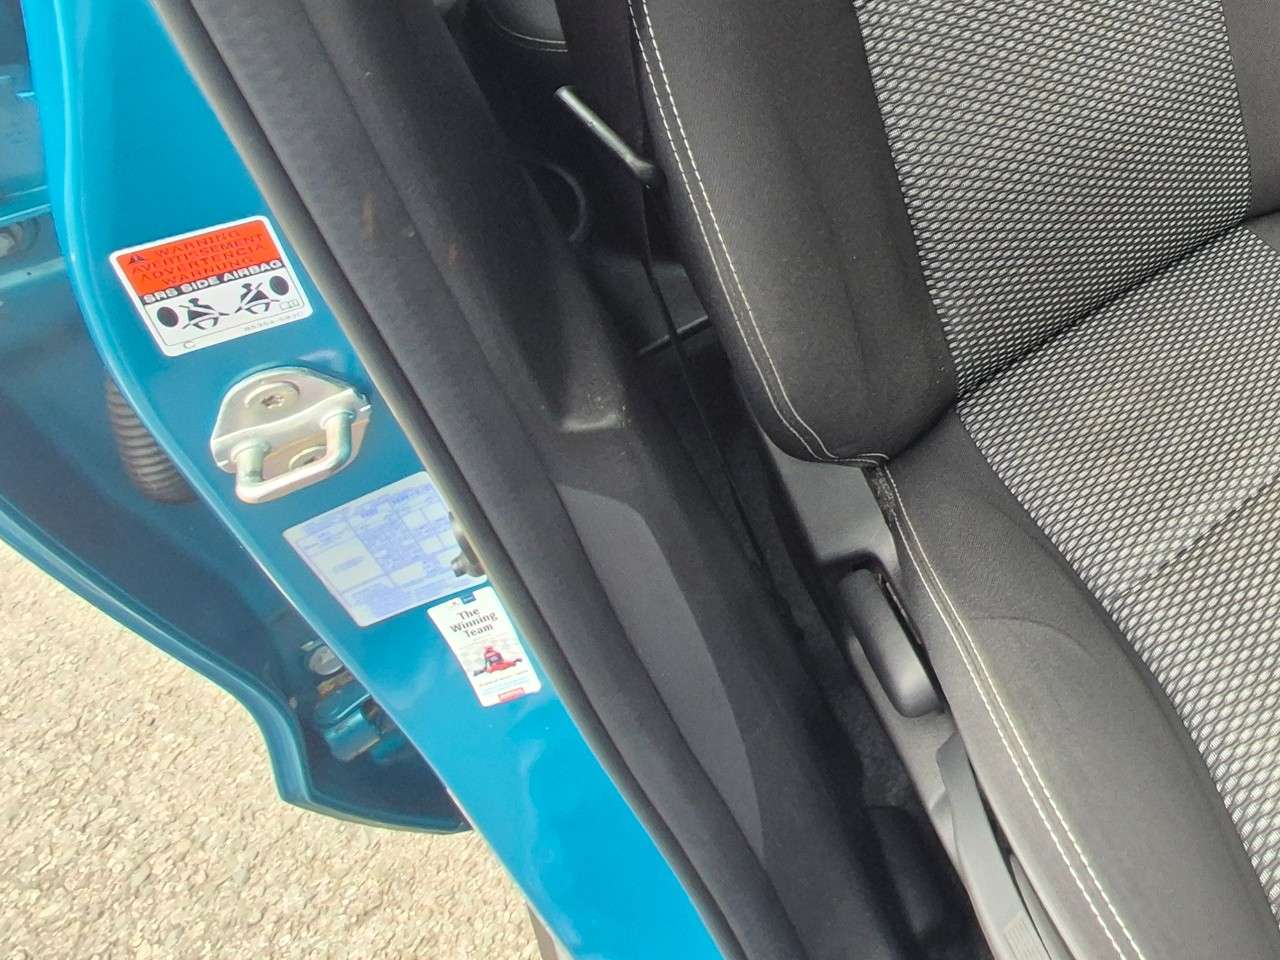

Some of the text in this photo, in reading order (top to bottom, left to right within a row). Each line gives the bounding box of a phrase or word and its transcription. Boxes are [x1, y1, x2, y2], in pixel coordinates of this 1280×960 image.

[154, 229, 241, 258] WARNING
[140, 243, 266, 282] ADVERTENCIA
[142, 259, 283, 305] SRS SIDE AIRBAG
[449, 612, 498, 633] Winning
[457, 608, 480, 621] The
[464, 624, 494, 638] Team
